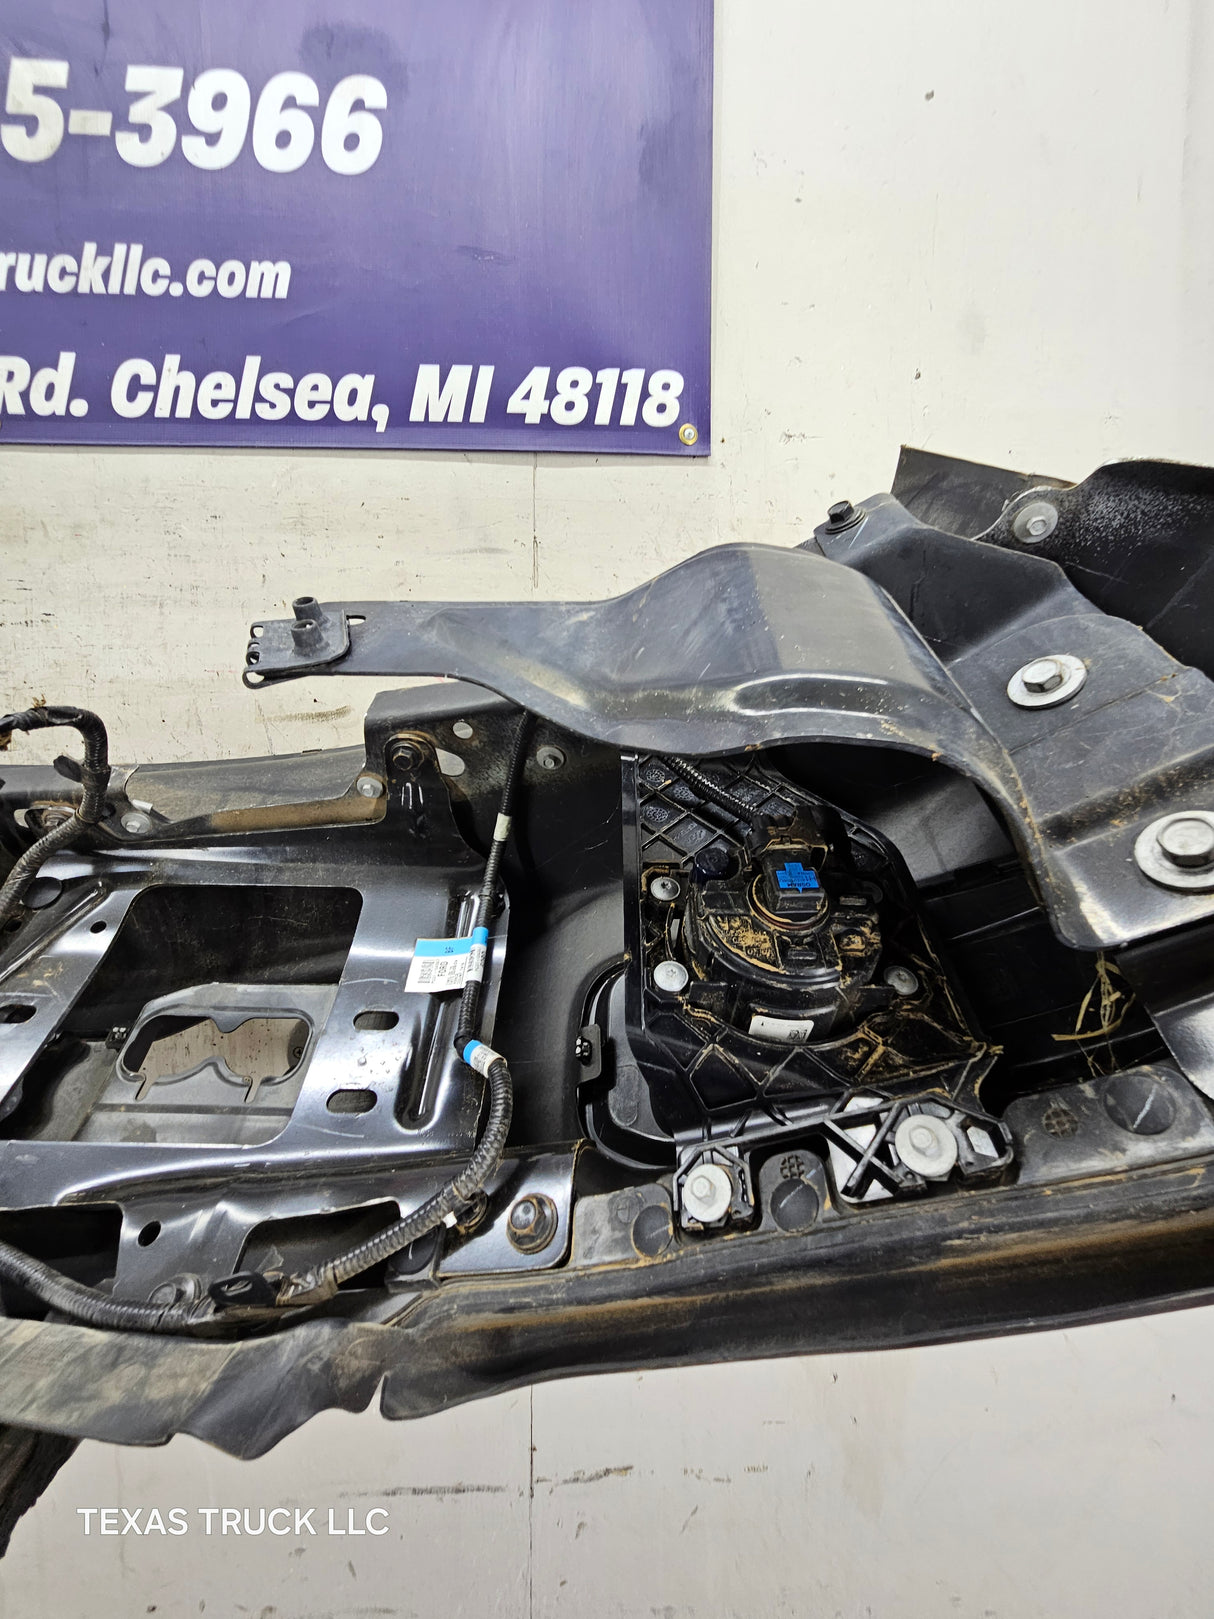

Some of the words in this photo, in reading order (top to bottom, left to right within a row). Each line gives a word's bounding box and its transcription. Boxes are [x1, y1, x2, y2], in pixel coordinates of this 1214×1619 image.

[0, 56, 389, 176] 5-3966
[0, 351, 89, 418] Rd.
[110, 353, 391, 433] Chelsea,
[409, 363, 495, 423] MI
[506, 366, 685, 428] 48118
